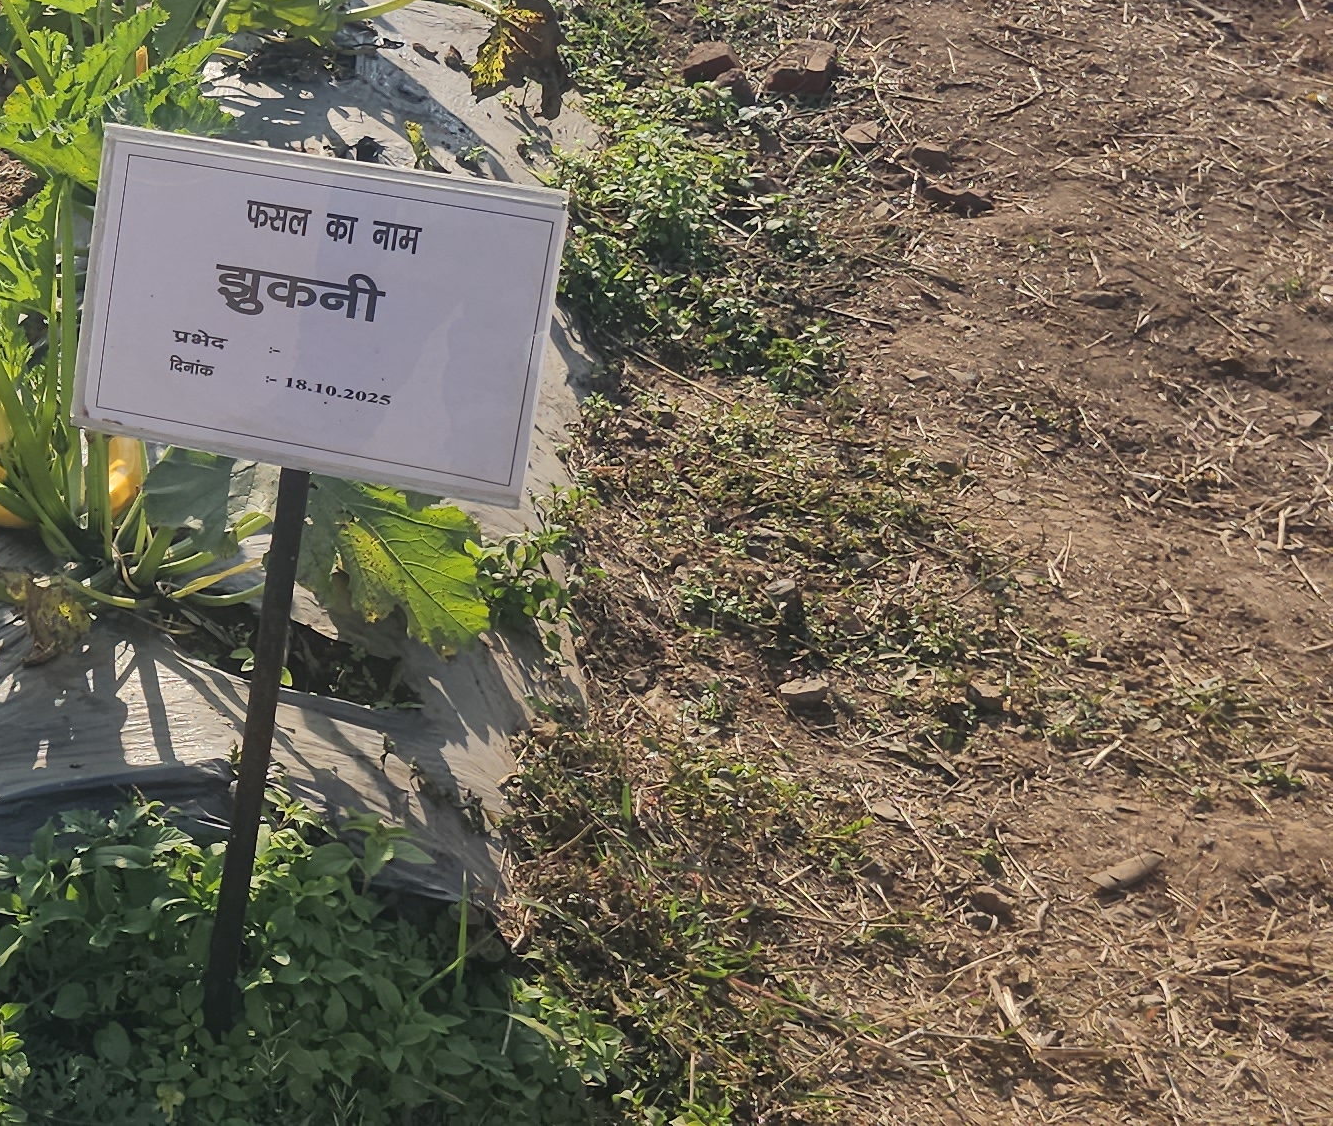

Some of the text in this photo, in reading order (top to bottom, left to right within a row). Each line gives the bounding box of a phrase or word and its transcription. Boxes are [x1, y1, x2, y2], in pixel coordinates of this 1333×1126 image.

[247, 200, 422, 254] फसल का नाम
[216, 264, 386, 322] झुकनी
[173, 329, 228, 350] प्रभेद
[170, 355, 215, 376] दिनांक
[285, 377, 391, 405] 18.10.2025
